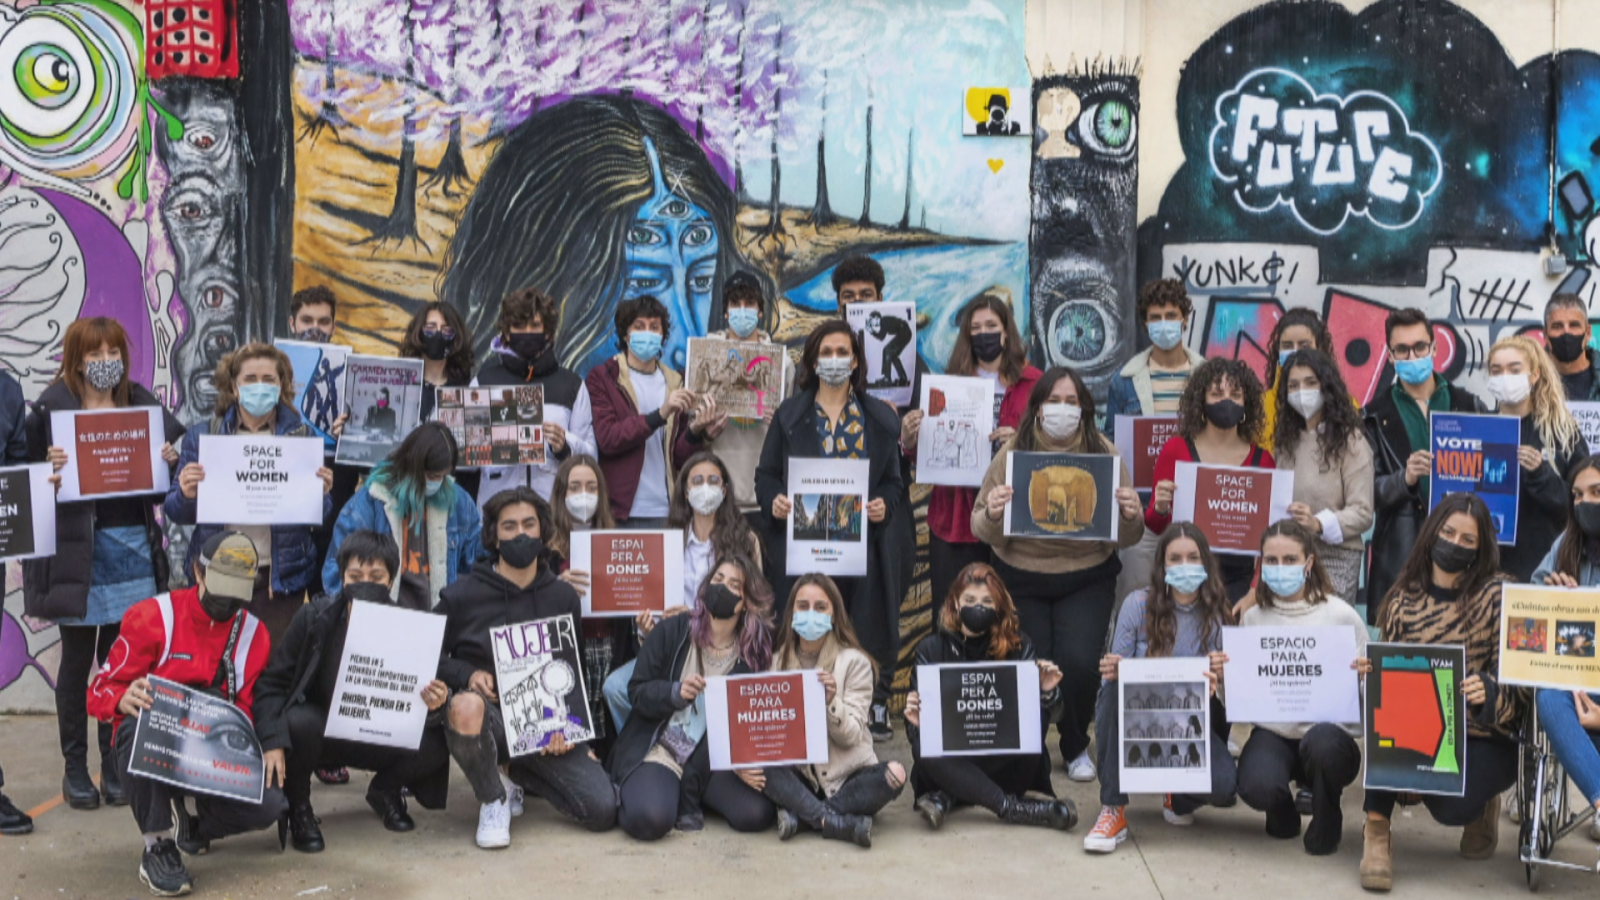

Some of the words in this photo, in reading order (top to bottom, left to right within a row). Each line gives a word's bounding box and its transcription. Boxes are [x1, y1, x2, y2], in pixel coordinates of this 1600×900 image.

[1572, 409, 1600, 419] ESPA
[1152, 424, 1178, 434] ESPA
[1436, 436, 1482, 450] VOTE
[243, 445, 282, 458] SPACE
[249, 459, 276, 470] FOR
[1436, 450, 1482, 478] NOW!
[236, 471, 288, 482] WOMEN
[1215, 474, 1253, 488] SPACE
[1221, 488, 1246, 500] FOR
[1208, 499, 1258, 514] WOMEN
[612, 539, 644, 550] ESPAI
[611, 552, 633, 562] PER
[636, 552, 644, 562] A
[606, 564, 650, 574] DONES
[494, 616, 575, 661] MUJER
[1260, 637, 1316, 650] ESPACIO
[1271, 651, 1308, 662] PARA
[1430, 658, 1454, 668] IVAM
[1258, 664, 1322, 676] MUJERES
[961, 672, 996, 685] ESPAI
[740, 682, 791, 696] ESPACIO
[961, 686, 986, 698] PER
[988, 685, 998, 698] A
[341, 691, 368, 708] AHORA,
[369, 696, 394, 712] PIENSA
[396, 700, 405, 712] EN
[406, 702, 412, 713] 5
[749, 696, 782, 709] PARA
[956, 698, 1003, 712] DONES
[338, 704, 372, 721] MUJERES.
[738, 708, 796, 724] MUJERES
